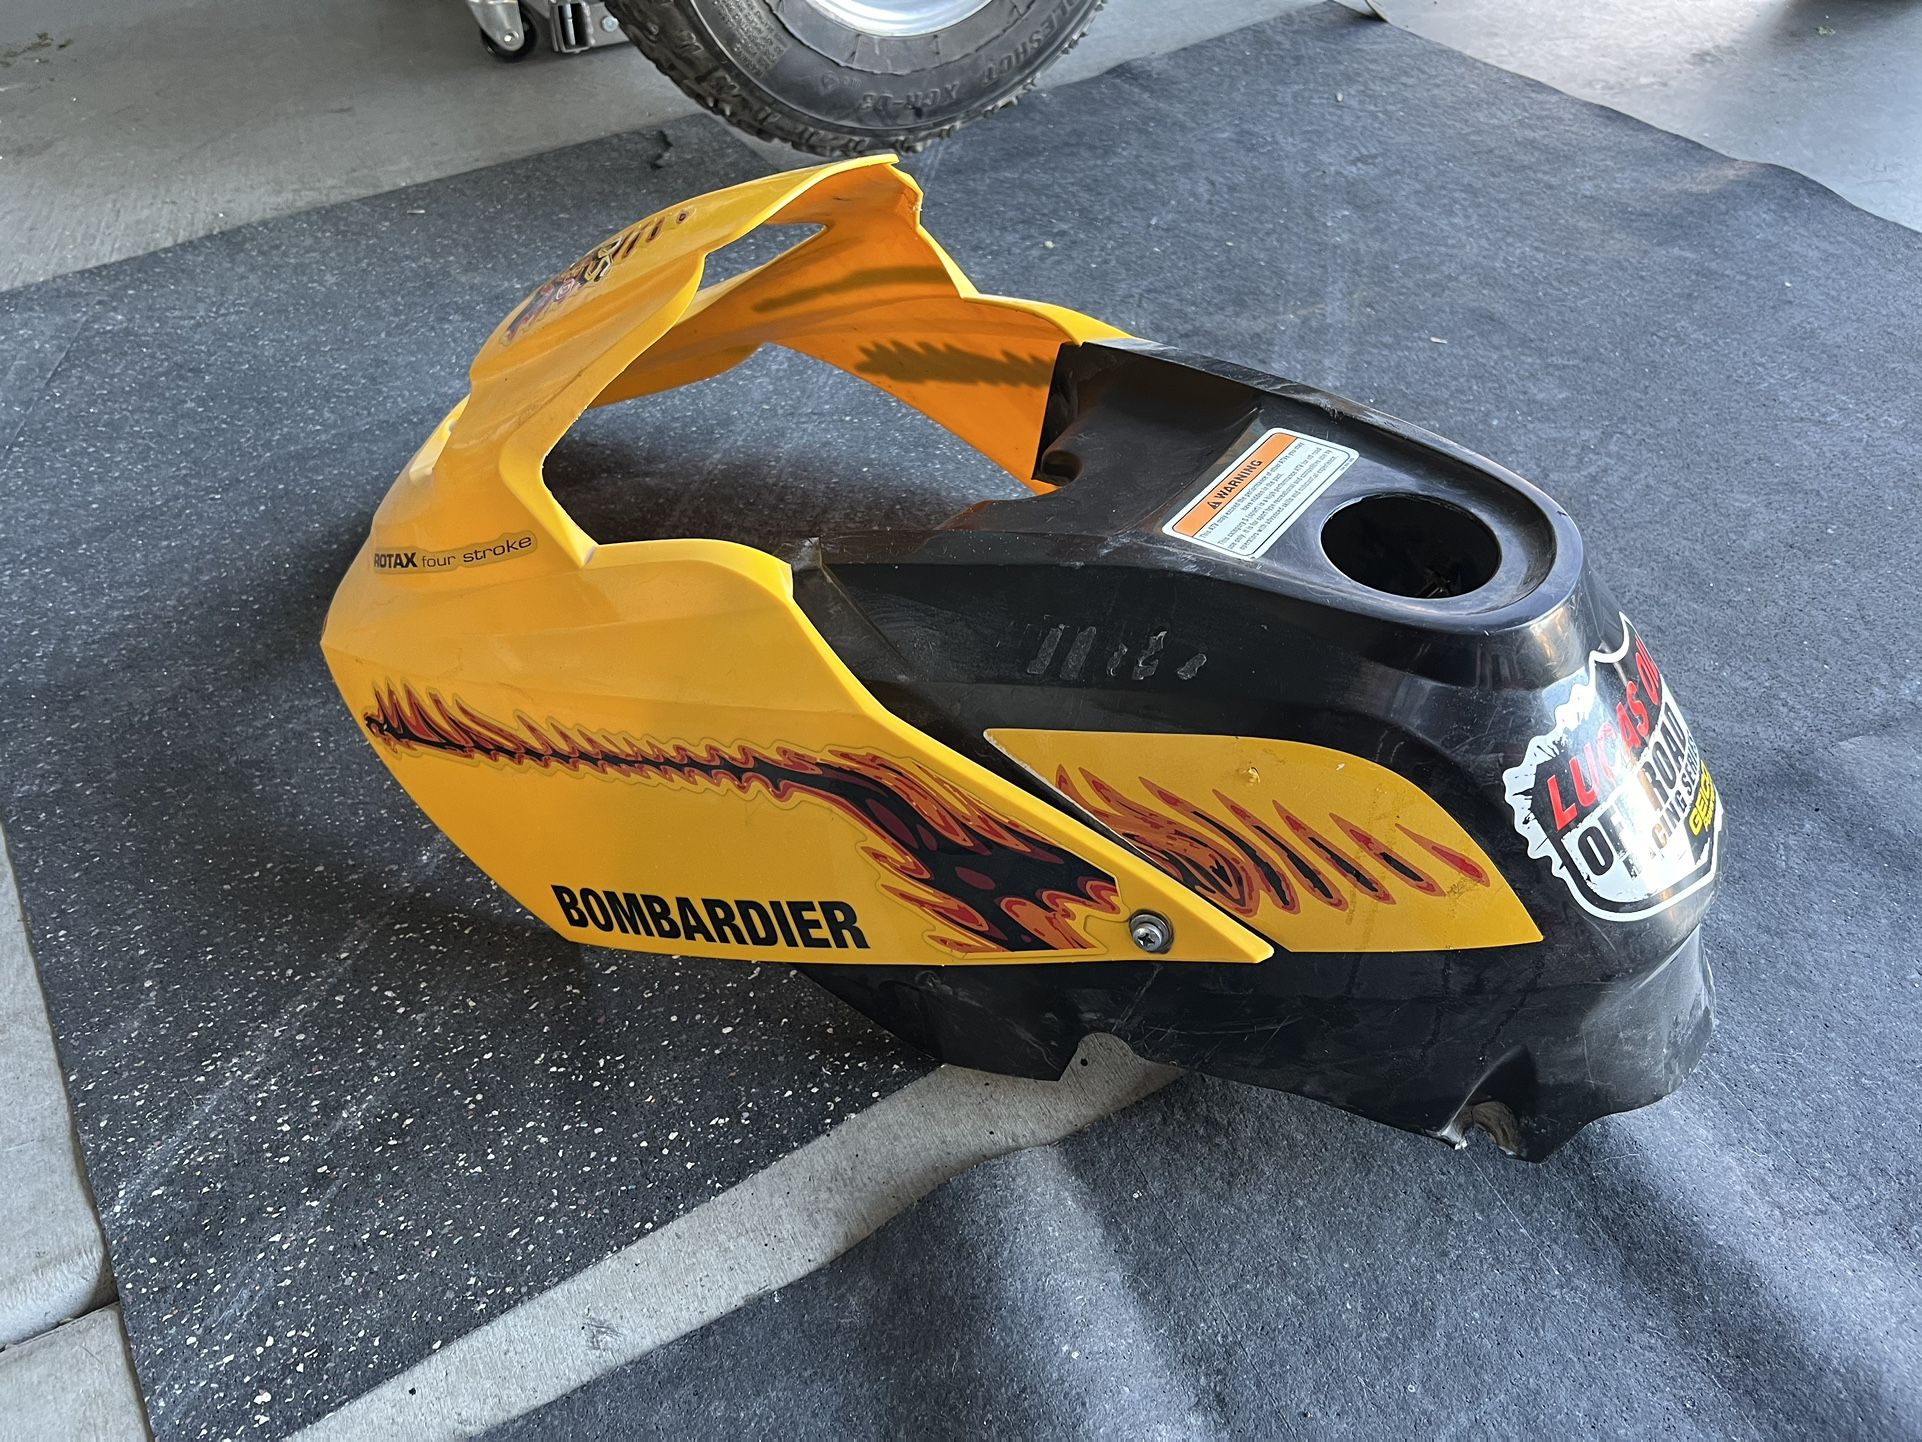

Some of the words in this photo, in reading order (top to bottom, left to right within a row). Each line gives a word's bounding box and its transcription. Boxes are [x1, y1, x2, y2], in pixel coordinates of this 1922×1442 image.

[1215, 459, 1263, 500] WARNING
[373, 551, 418, 569] ROTAX
[422, 555, 456, 568] four
[462, 536, 533, 564] stroke
[1547, 680, 1649, 832] LUCAS
[1637, 701, 1687, 813] ROAD
[550, 884, 871, 950] BOMBARDIER
